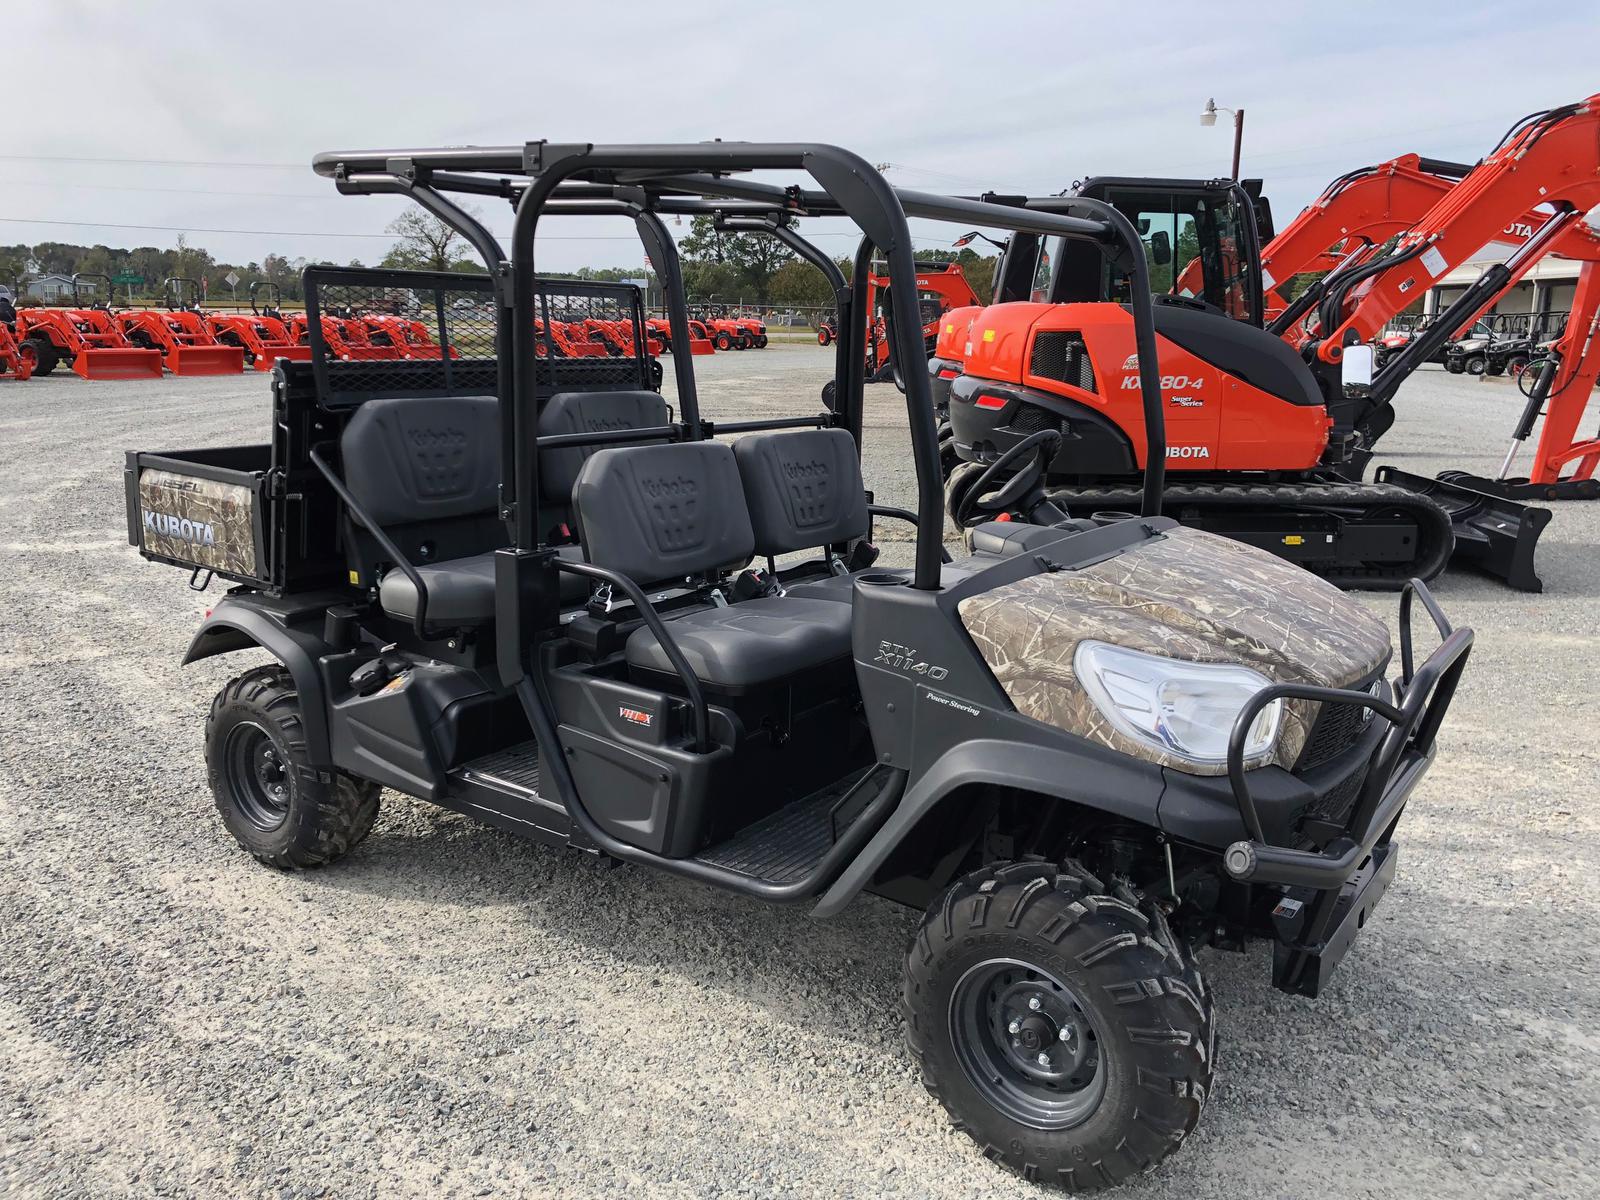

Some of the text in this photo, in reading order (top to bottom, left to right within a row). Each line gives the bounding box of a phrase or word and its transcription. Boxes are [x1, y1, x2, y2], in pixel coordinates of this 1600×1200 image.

[1120, 375, 1204, 390] KX80-4
[143, 510, 215, 546] KUBOTA
[880, 640, 917, 658] RTV
[874, 649, 949, 680] X1140
[926, 693, 980, 716] Power Steering
